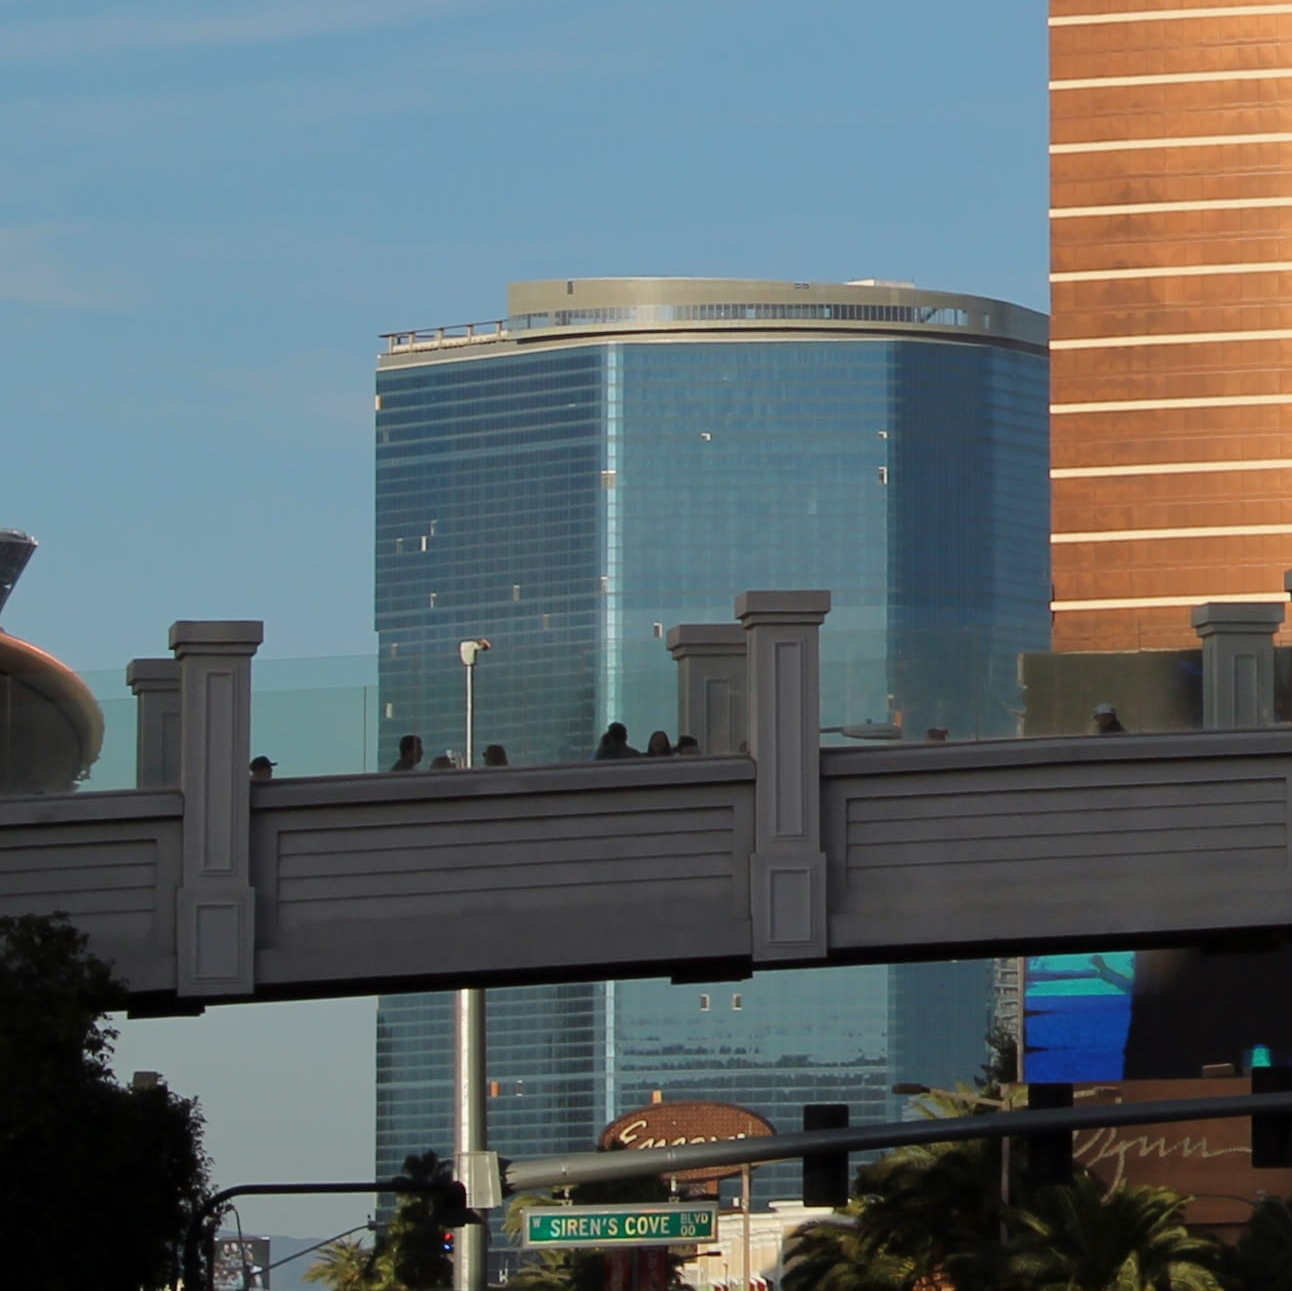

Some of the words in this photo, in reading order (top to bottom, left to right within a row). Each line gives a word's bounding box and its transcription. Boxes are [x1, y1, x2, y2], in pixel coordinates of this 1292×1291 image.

[549, 1215, 619, 1239] SIREN'S
[624, 1214, 672, 1237] COVE
[680, 1211, 709, 1224] BLVD
